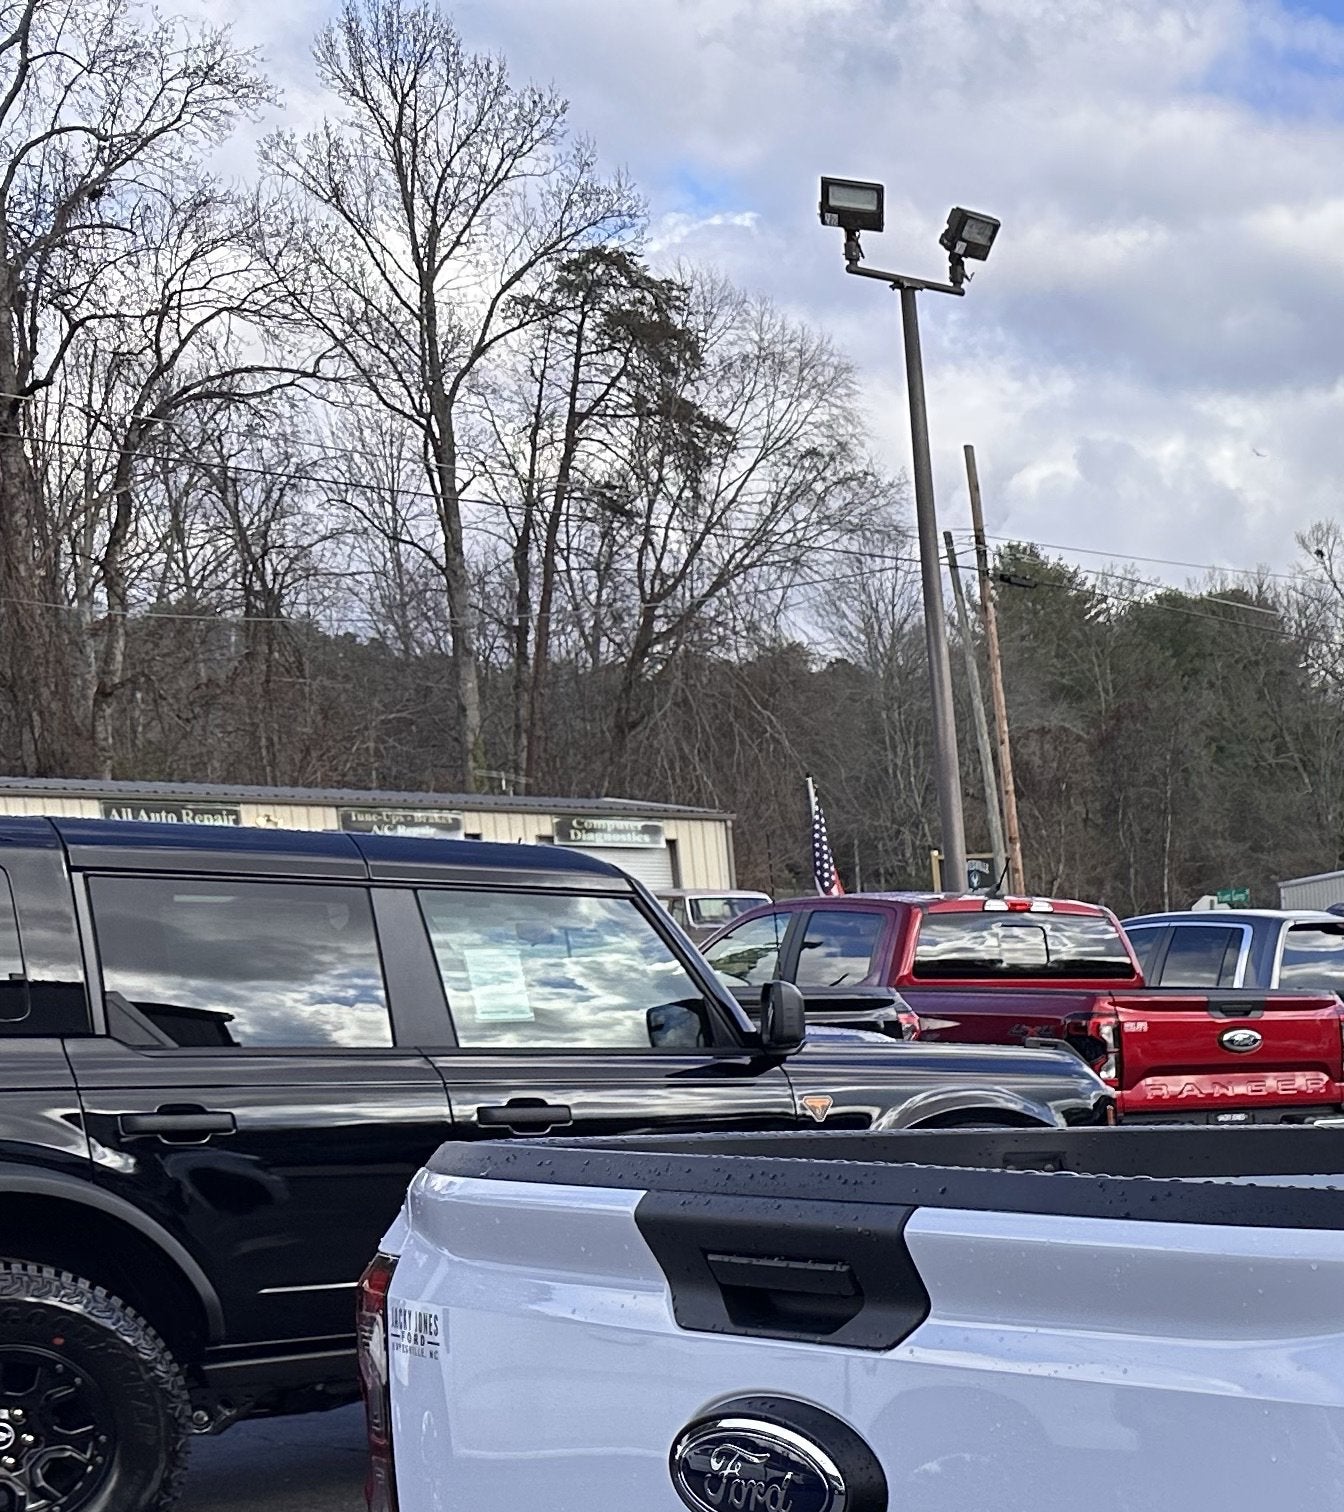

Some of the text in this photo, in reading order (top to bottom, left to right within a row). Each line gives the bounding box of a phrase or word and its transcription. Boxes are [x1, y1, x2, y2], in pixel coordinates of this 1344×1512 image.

[110, 807, 237, 826] All Auto Repair
[1145, 1077, 1328, 1099] RANGER
[414, 1310, 439, 1337] JONES
[401, 1330, 425, 1347] FORD
